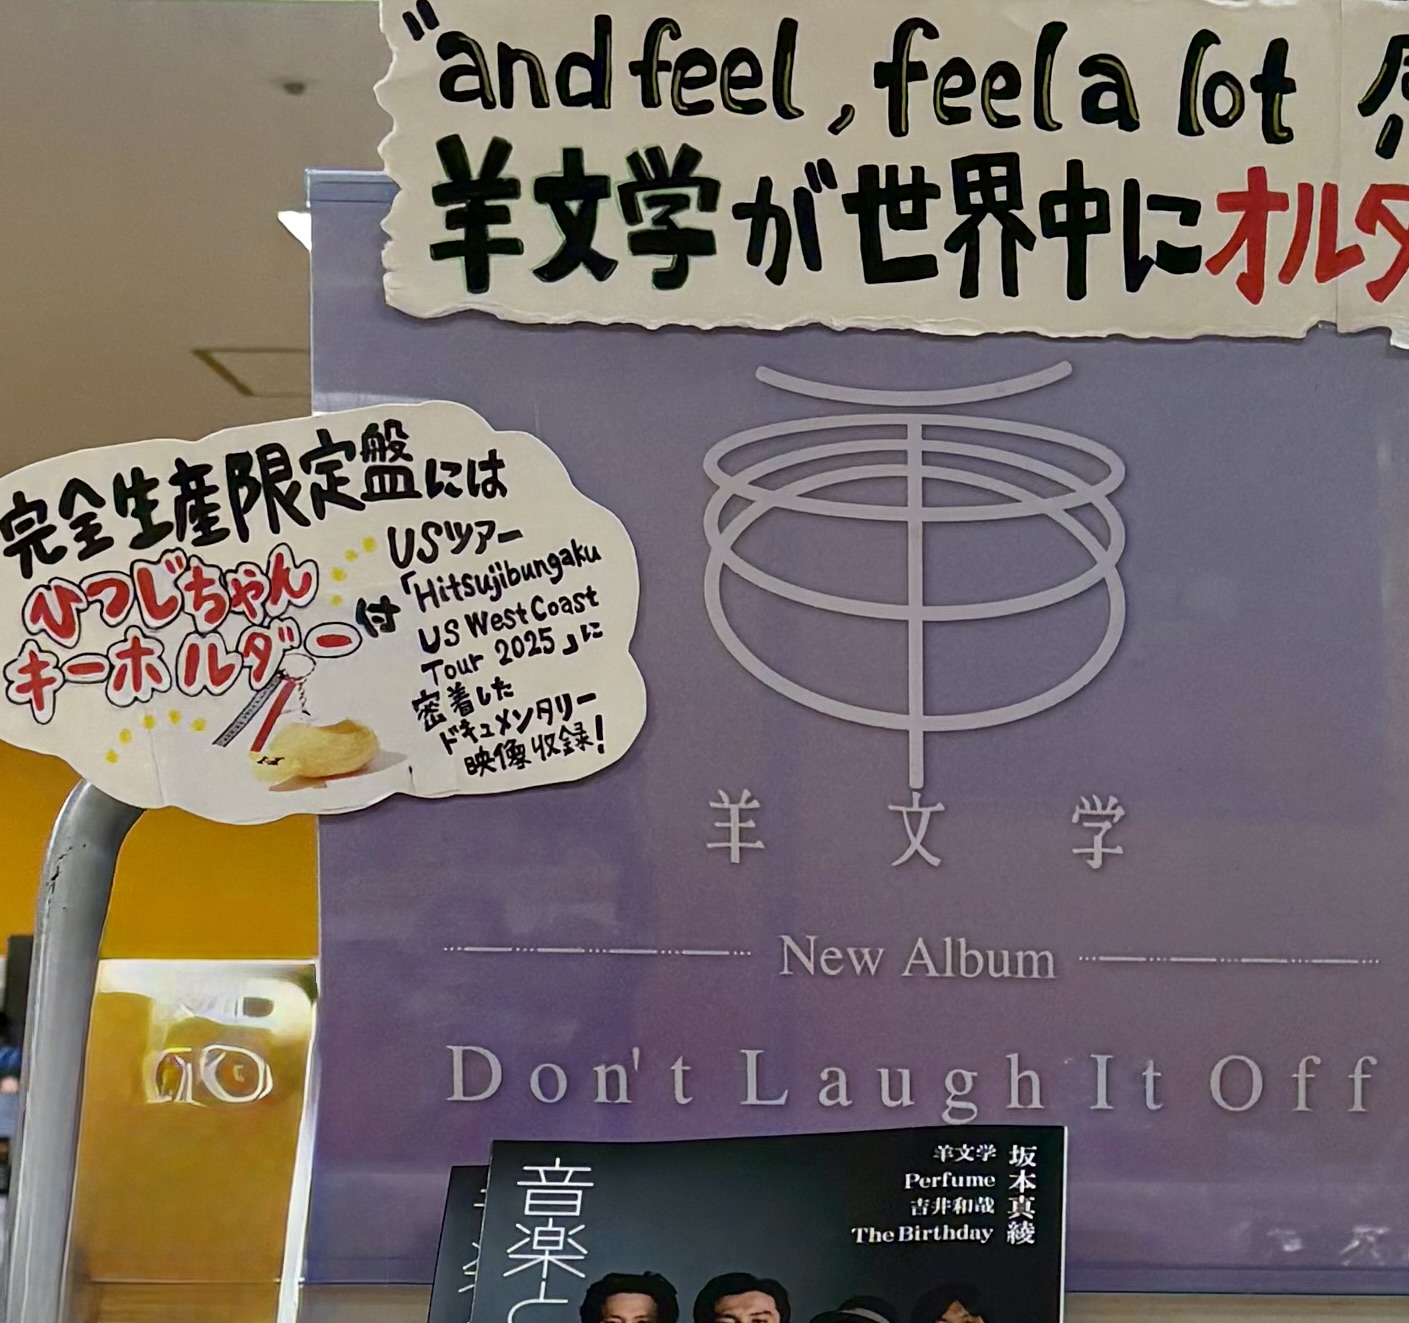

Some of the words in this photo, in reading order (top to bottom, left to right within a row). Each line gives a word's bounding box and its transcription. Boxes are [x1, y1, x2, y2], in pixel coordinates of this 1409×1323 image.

[874, 17, 1067, 137] feel
[1079, 50, 1140, 131] a
[1178, 28, 1296, 146] lot
[0, 419, 508, 580] 完全生産限定盤には
[23, 543, 318, 648] ひつじちゃん
[356, 596, 400, 640] 付
[418, 624, 464, 653] US
[468, 604, 526, 638] West
[531, 589, 599, 623] Coast
[6, 616, 361, 724] キーホルダー
[422, 653, 484, 684] Tour
[412, 675, 515, 733] 密着した
[442, 691, 598, 755] ドキュメンタリー
[779, 933, 885, 977] New
[900, 935, 1057, 980] Album
[446, 1042, 695, 1106] Don't
[740, 1047, 1044, 1125] Laugh
[1089, 1053, 1165, 1112] It
[1209, 1053, 1379, 1114] Off
[905, 1172, 995, 1191] Perfume
[933, 1144, 997, 1163] 羊文学
[910, 1197, 995, 1217] 吉井和哉
[1006, 1145, 1038, 1246] 坂本真綾
[851, 1225, 895, 1245] The
[898, 1224, 994, 1244] Birthday
